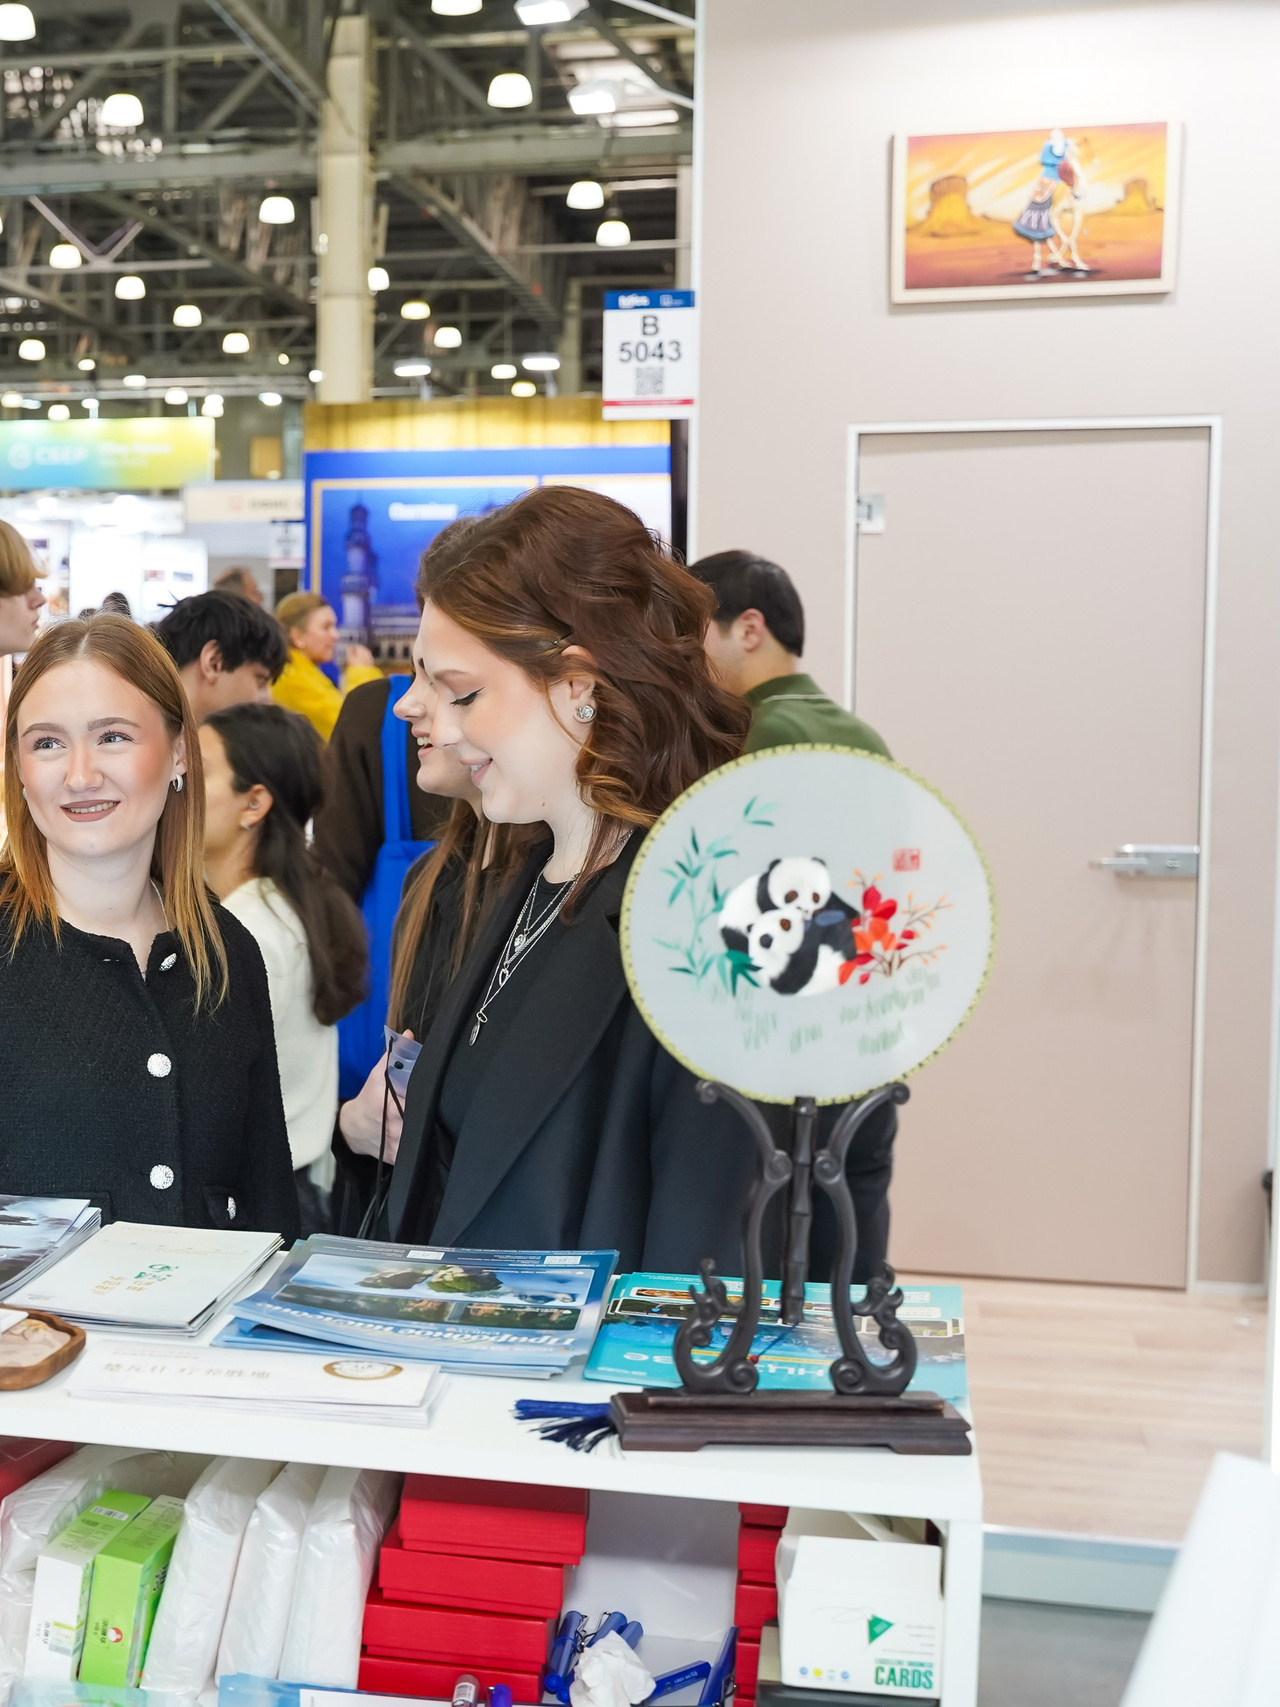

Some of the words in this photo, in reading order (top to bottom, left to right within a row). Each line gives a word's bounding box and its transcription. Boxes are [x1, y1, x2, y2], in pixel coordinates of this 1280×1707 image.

[641, 315, 659, 336] B
[618, 341, 682, 363] 5043
[875, 1665, 933, 1689] CARDS
